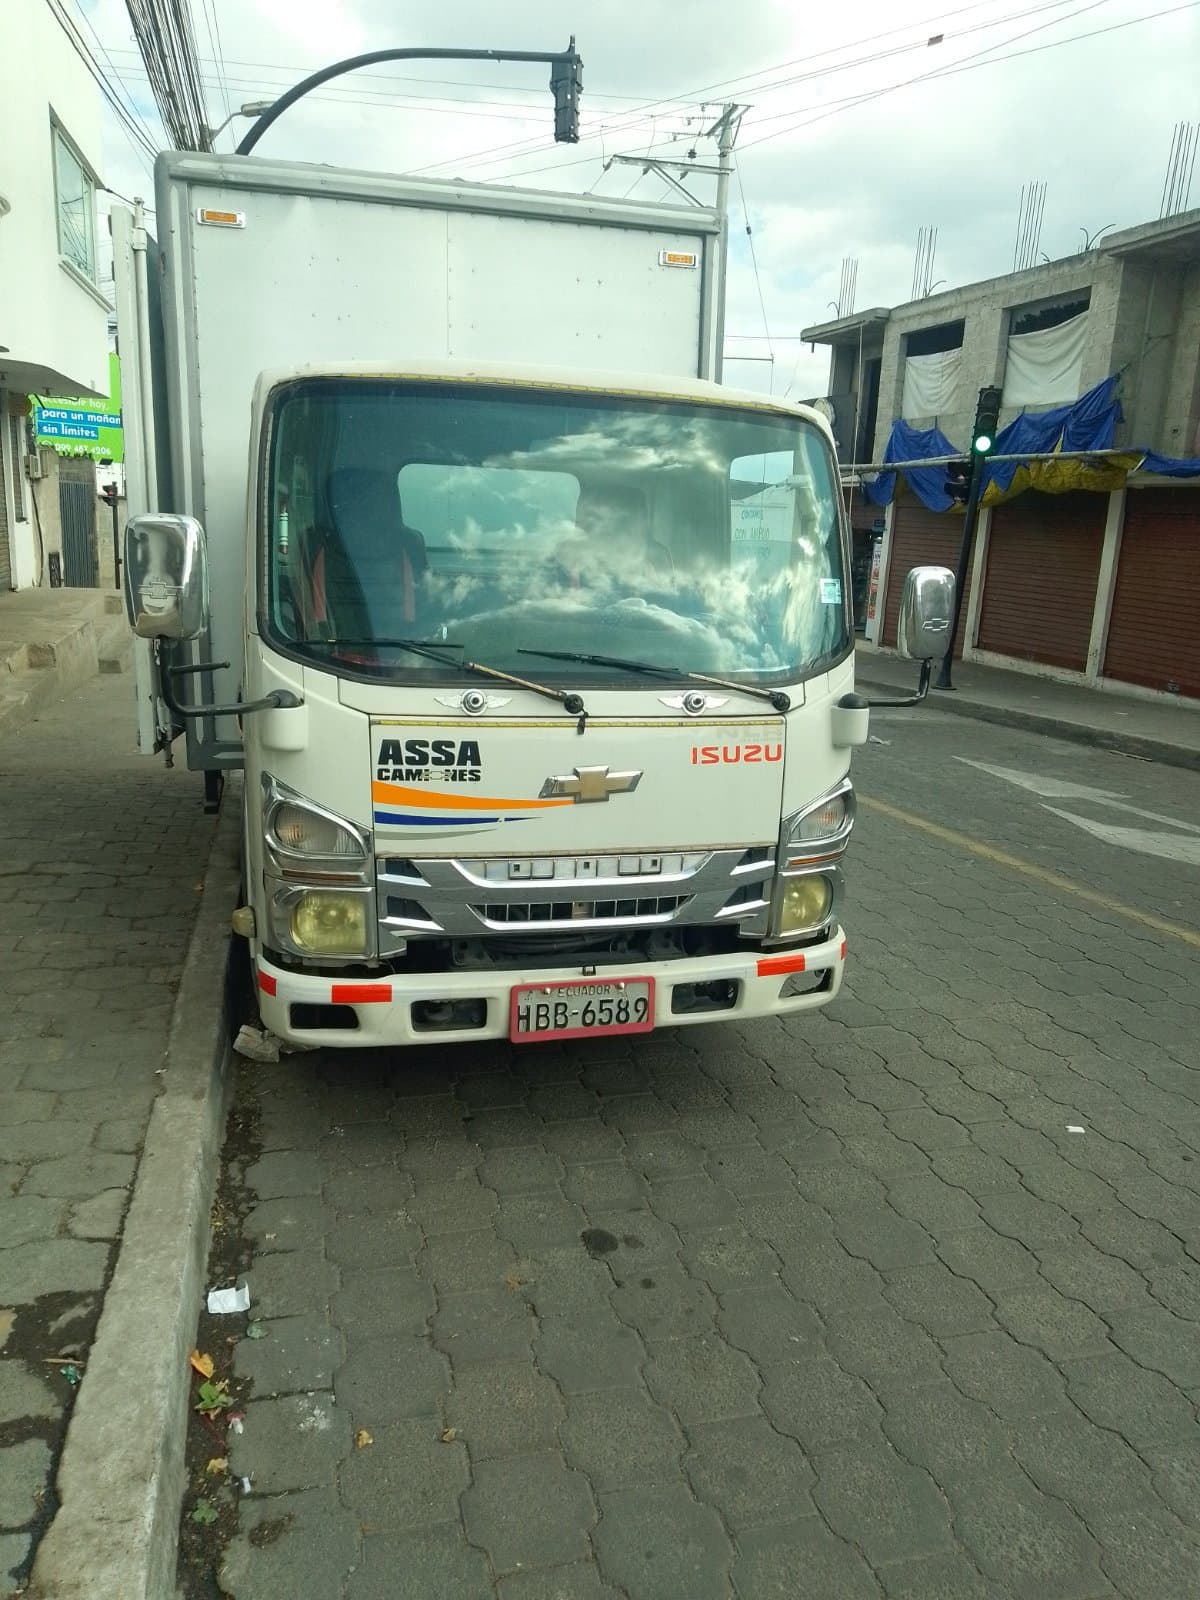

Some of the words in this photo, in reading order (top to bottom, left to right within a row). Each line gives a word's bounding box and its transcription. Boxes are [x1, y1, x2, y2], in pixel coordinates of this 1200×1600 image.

[42, 409, 68, 421] para
[71, 412, 84, 421] un
[87, 414, 121, 425] mañan
[42, 423, 58, 434] sin
[377, 738, 482, 766] ASSA
[691, 744, 782, 764] ISUZU
[376, 767, 482, 782] CAMINES
[557, 984, 611, 998] ECUADOR
[517, 997, 649, 1033] HBB-6589
